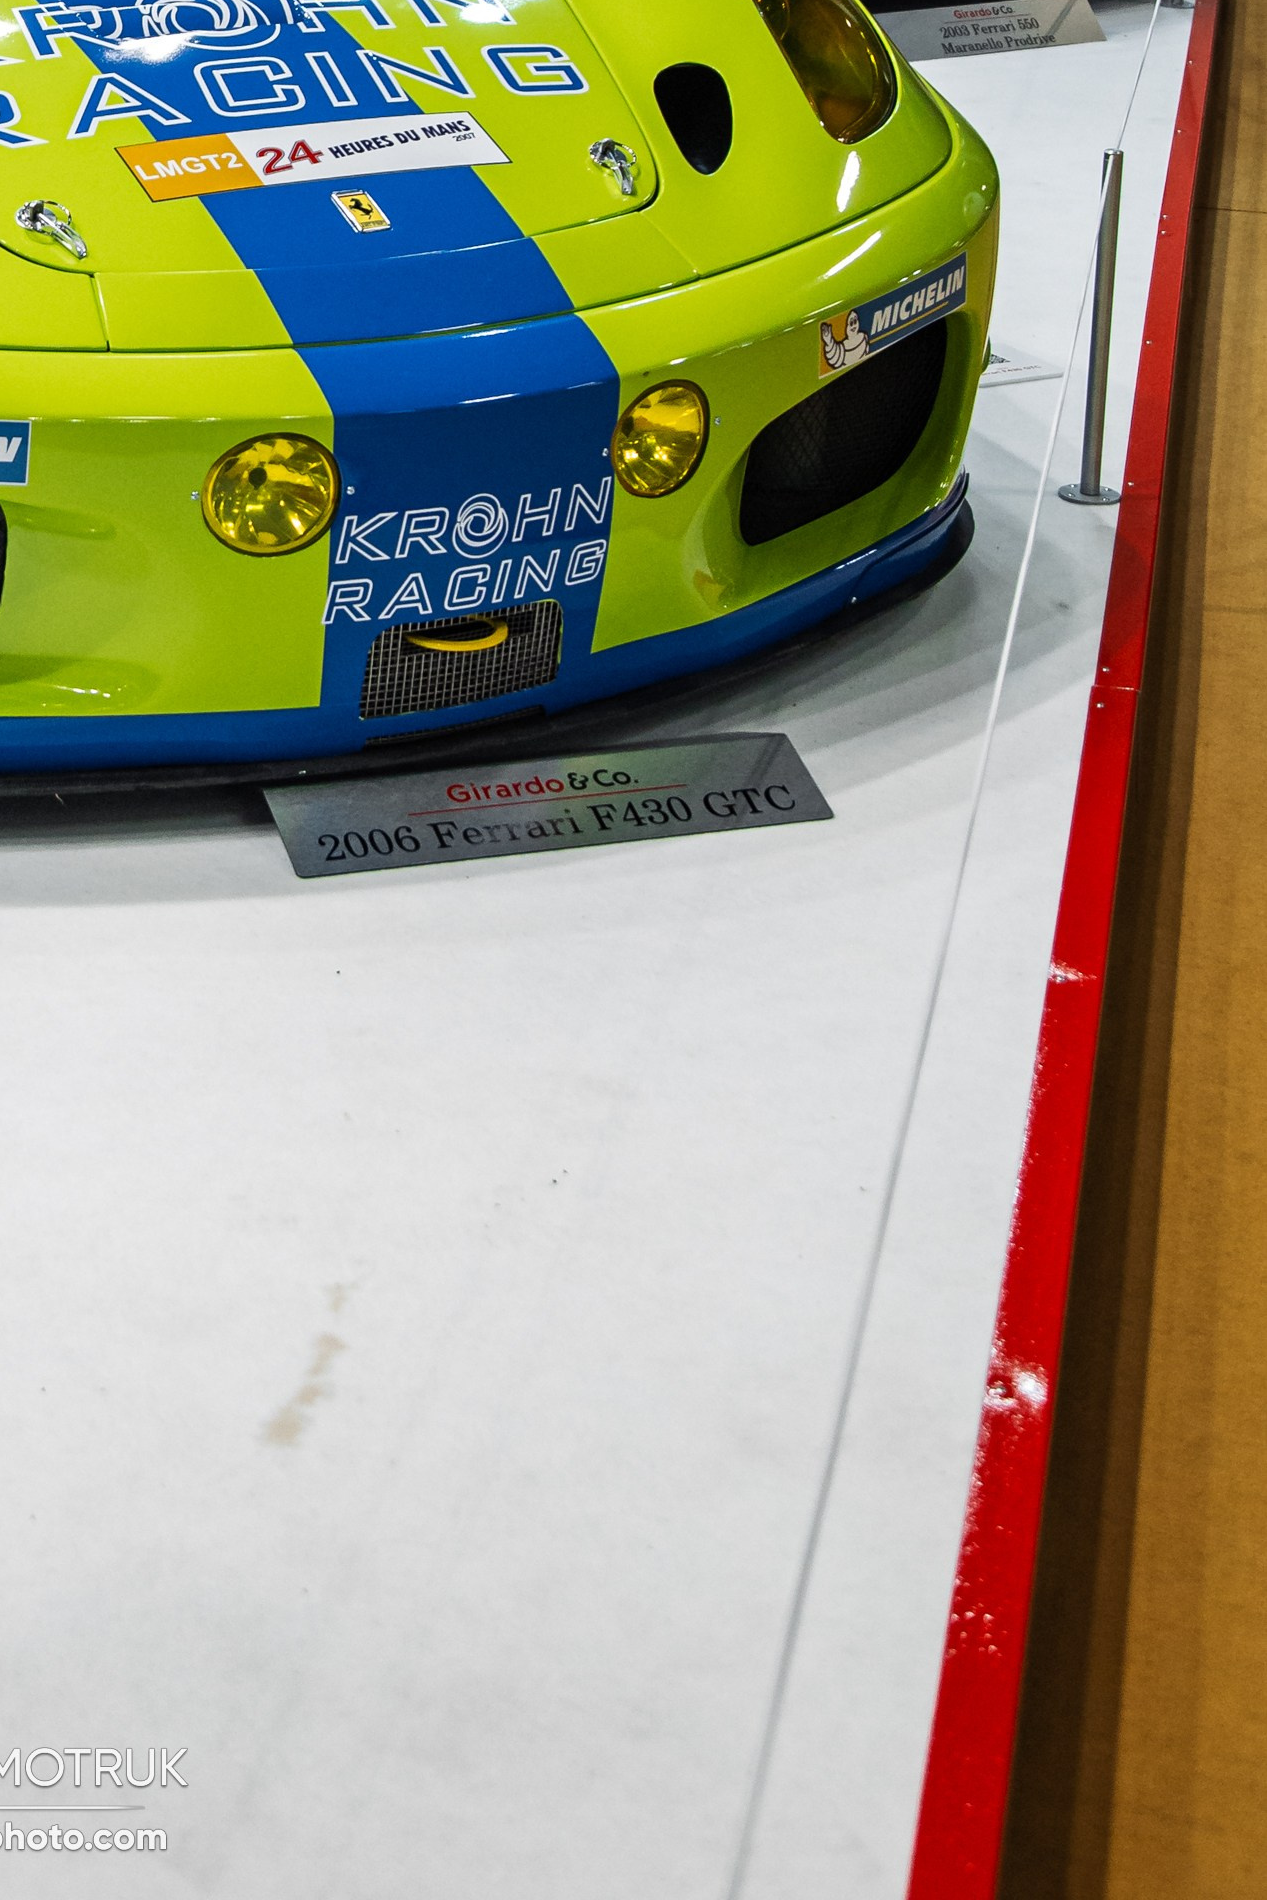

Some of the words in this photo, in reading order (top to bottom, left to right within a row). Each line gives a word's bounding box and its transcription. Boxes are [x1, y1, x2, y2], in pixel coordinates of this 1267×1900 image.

[940, 25, 971, 39] 2003
[971, 20, 1016, 36] Ferrari
[1017, 17, 1040, 30] 550
[954, 8, 992, 19] Girardo
[941, 38, 1004, 55] Maranello
[1004, 33, 1056, 48] Prodrive
[256, 140, 323, 175] 24
[328, 134, 395, 160] HEURES
[397, 128, 420, 146] DU
[424, 120, 472, 140] MANS
[452, 131, 477, 143] 2007
[135, 152, 243, 183] LMGT2
[870, 265, 965, 336] MICHELIN
[335, 476, 612, 564] KROHN
[322, 539, 609, 624] RACING
[446, 775, 565, 804] Girardo
[317, 826, 421, 863] 2006
[427, 808, 581, 850] Ferrari
[588, 796, 693, 832] F430
[703, 784, 797, 818] GTC
